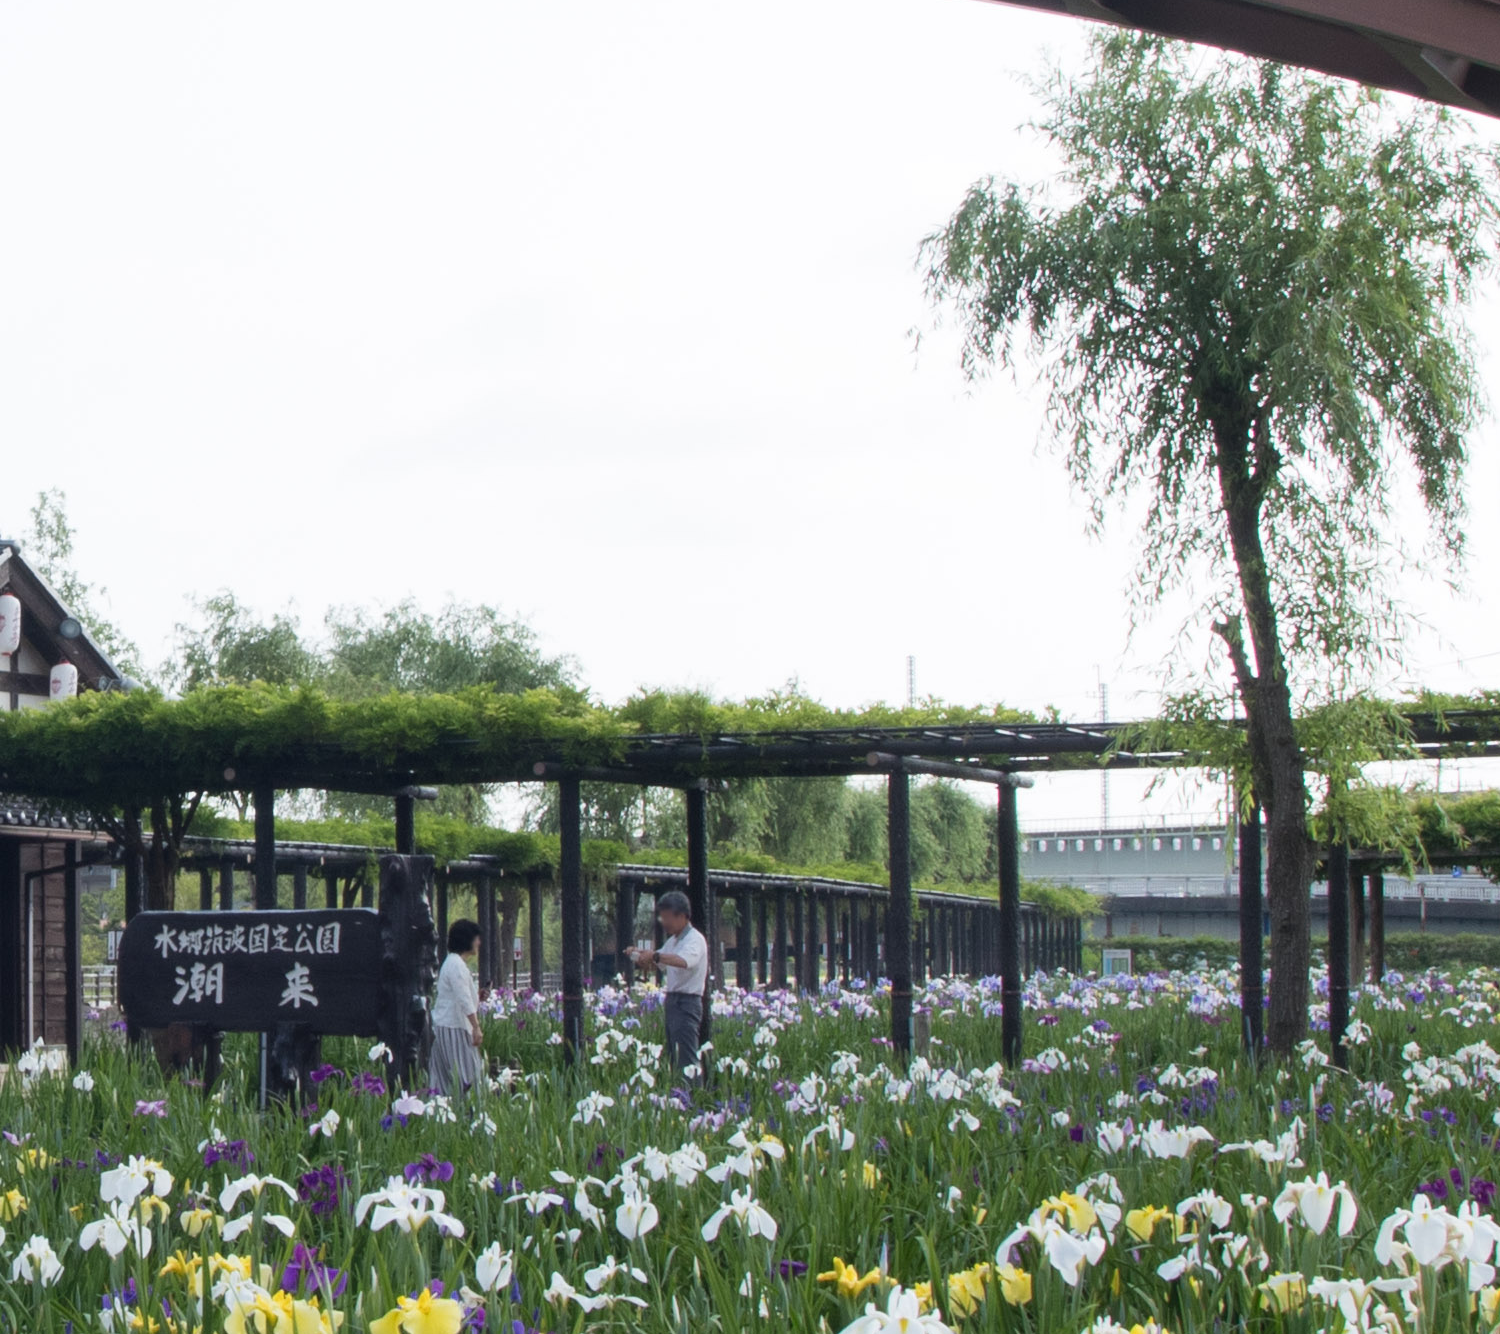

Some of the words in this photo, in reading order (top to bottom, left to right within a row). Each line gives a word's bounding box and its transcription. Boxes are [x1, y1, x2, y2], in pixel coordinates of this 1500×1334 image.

[153, 922, 341, 958] 水郷筑波国定公園
